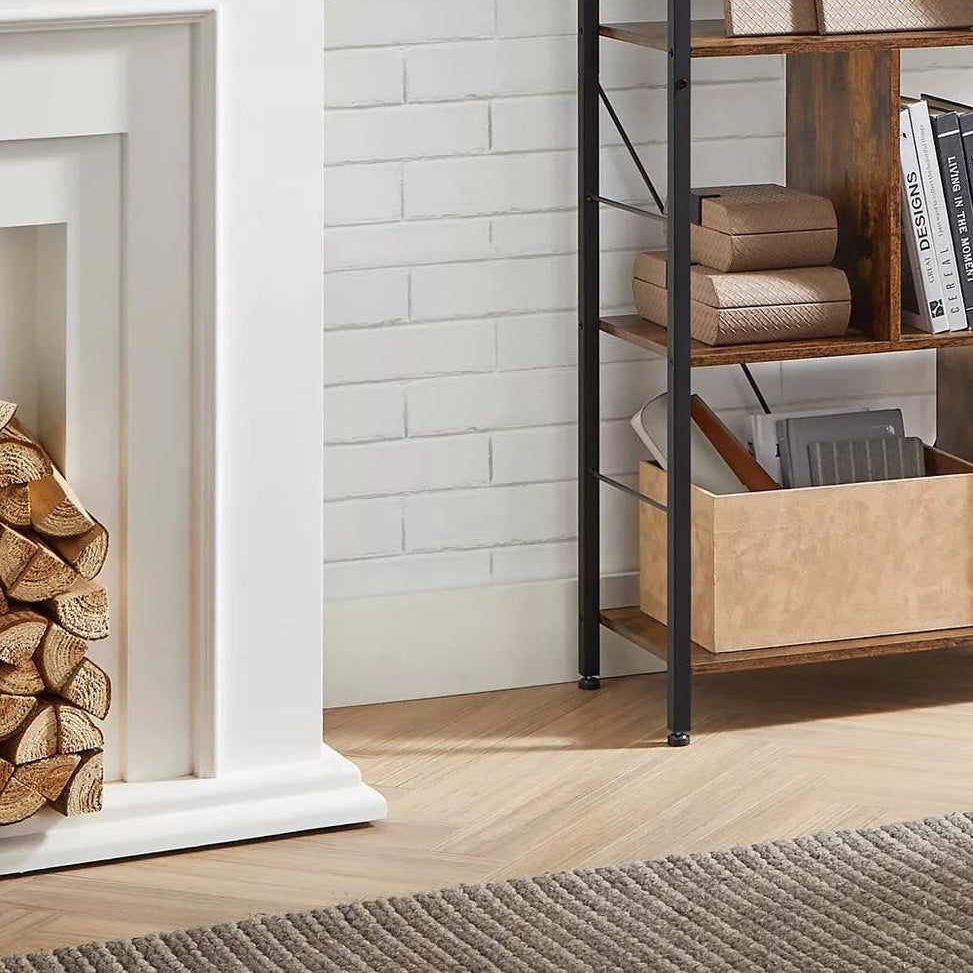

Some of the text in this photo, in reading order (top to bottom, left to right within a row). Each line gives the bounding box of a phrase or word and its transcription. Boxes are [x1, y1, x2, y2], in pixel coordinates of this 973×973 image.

[947, 155, 961, 192] LIVING
[907, 171, 930, 251] DESIGNS
[954, 195, 964, 207] IN
[957, 211, 968, 233] THE
[940, 247, 960, 313] CEREAL
